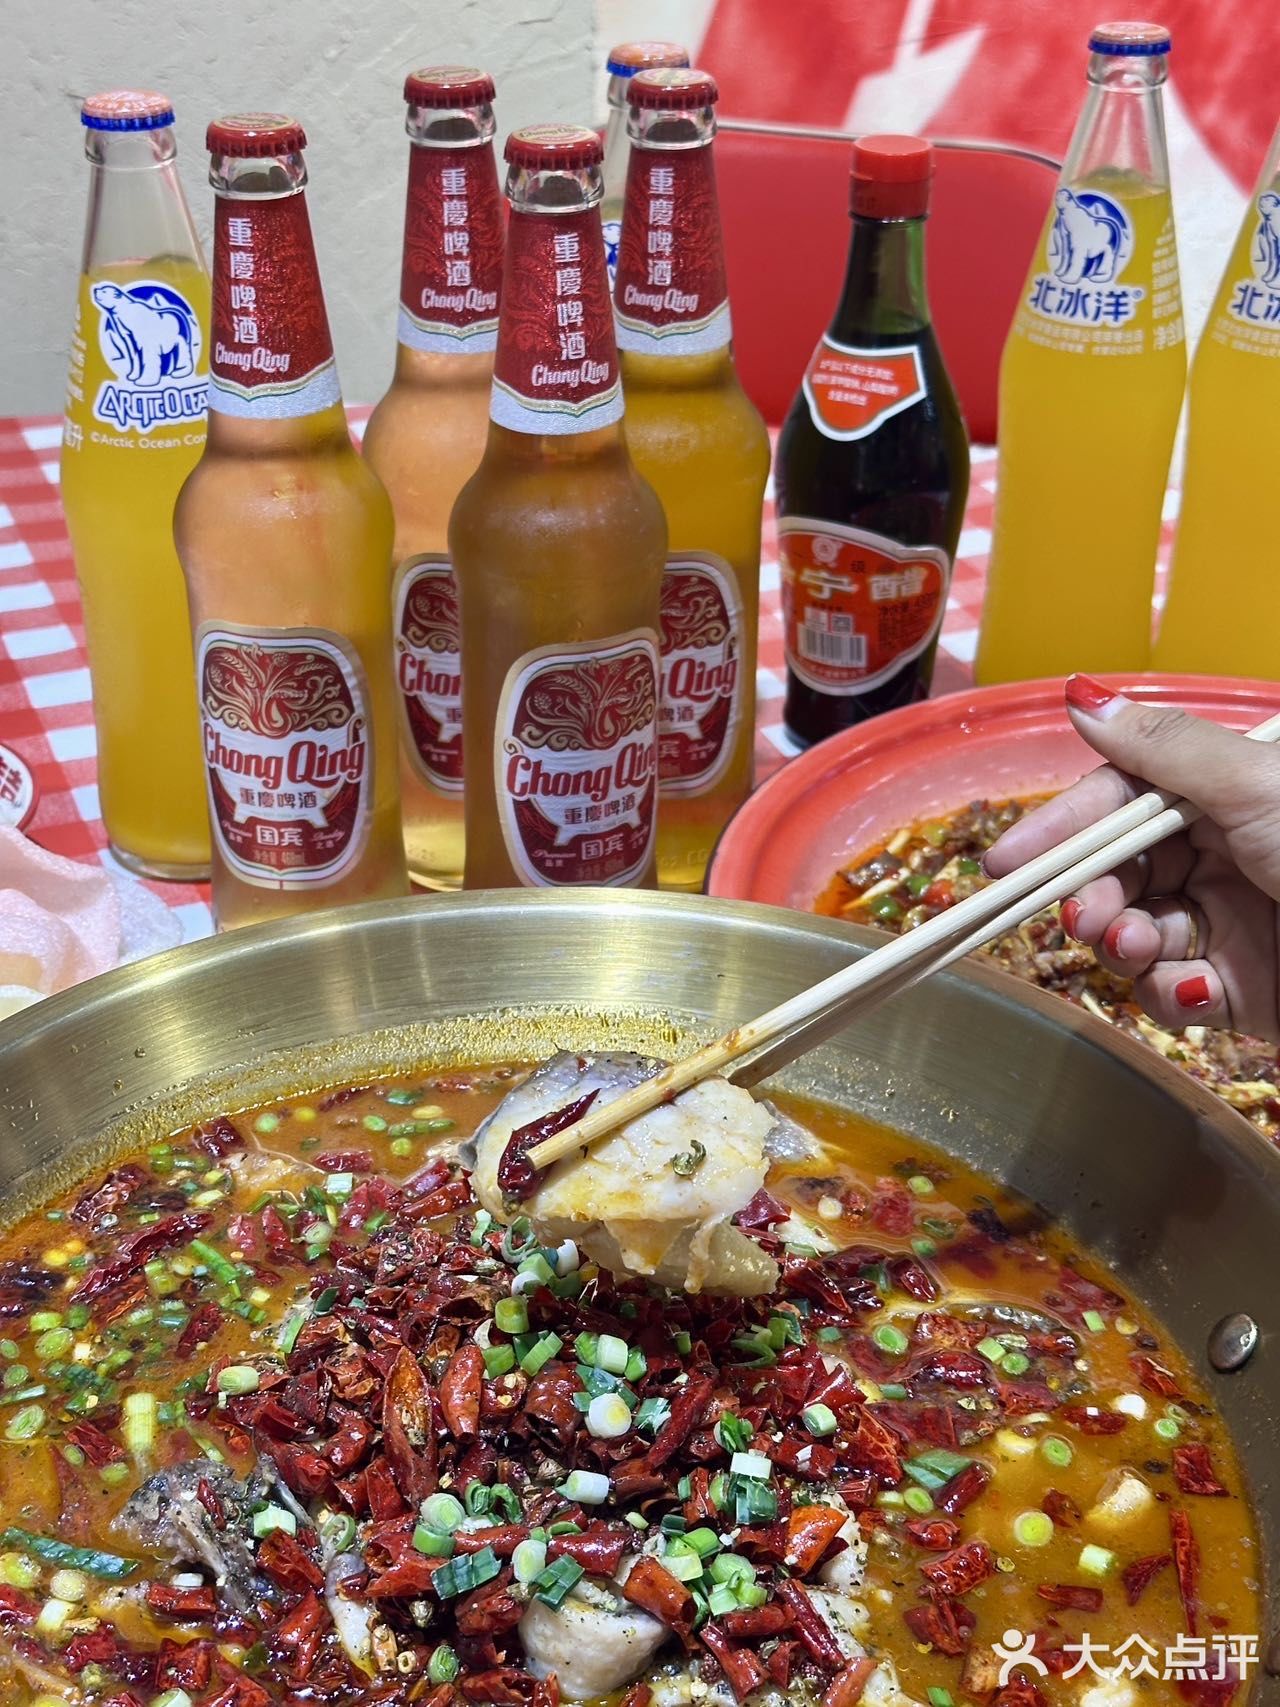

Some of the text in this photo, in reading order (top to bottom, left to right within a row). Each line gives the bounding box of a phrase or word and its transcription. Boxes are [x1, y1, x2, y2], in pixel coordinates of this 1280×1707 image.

[440, 168, 471, 288] 重慶啤酒
[646, 168, 674, 287] 重慶啤酒
[553, 232, 586, 361] 重慶啤酒
[138, 437, 181, 449] Ocean
[659, 741, 681, 759] 宾
[505, 753, 613, 803] Chong
[255, 825, 304, 847] 国宾
[581, 833, 625, 861] 国宾
